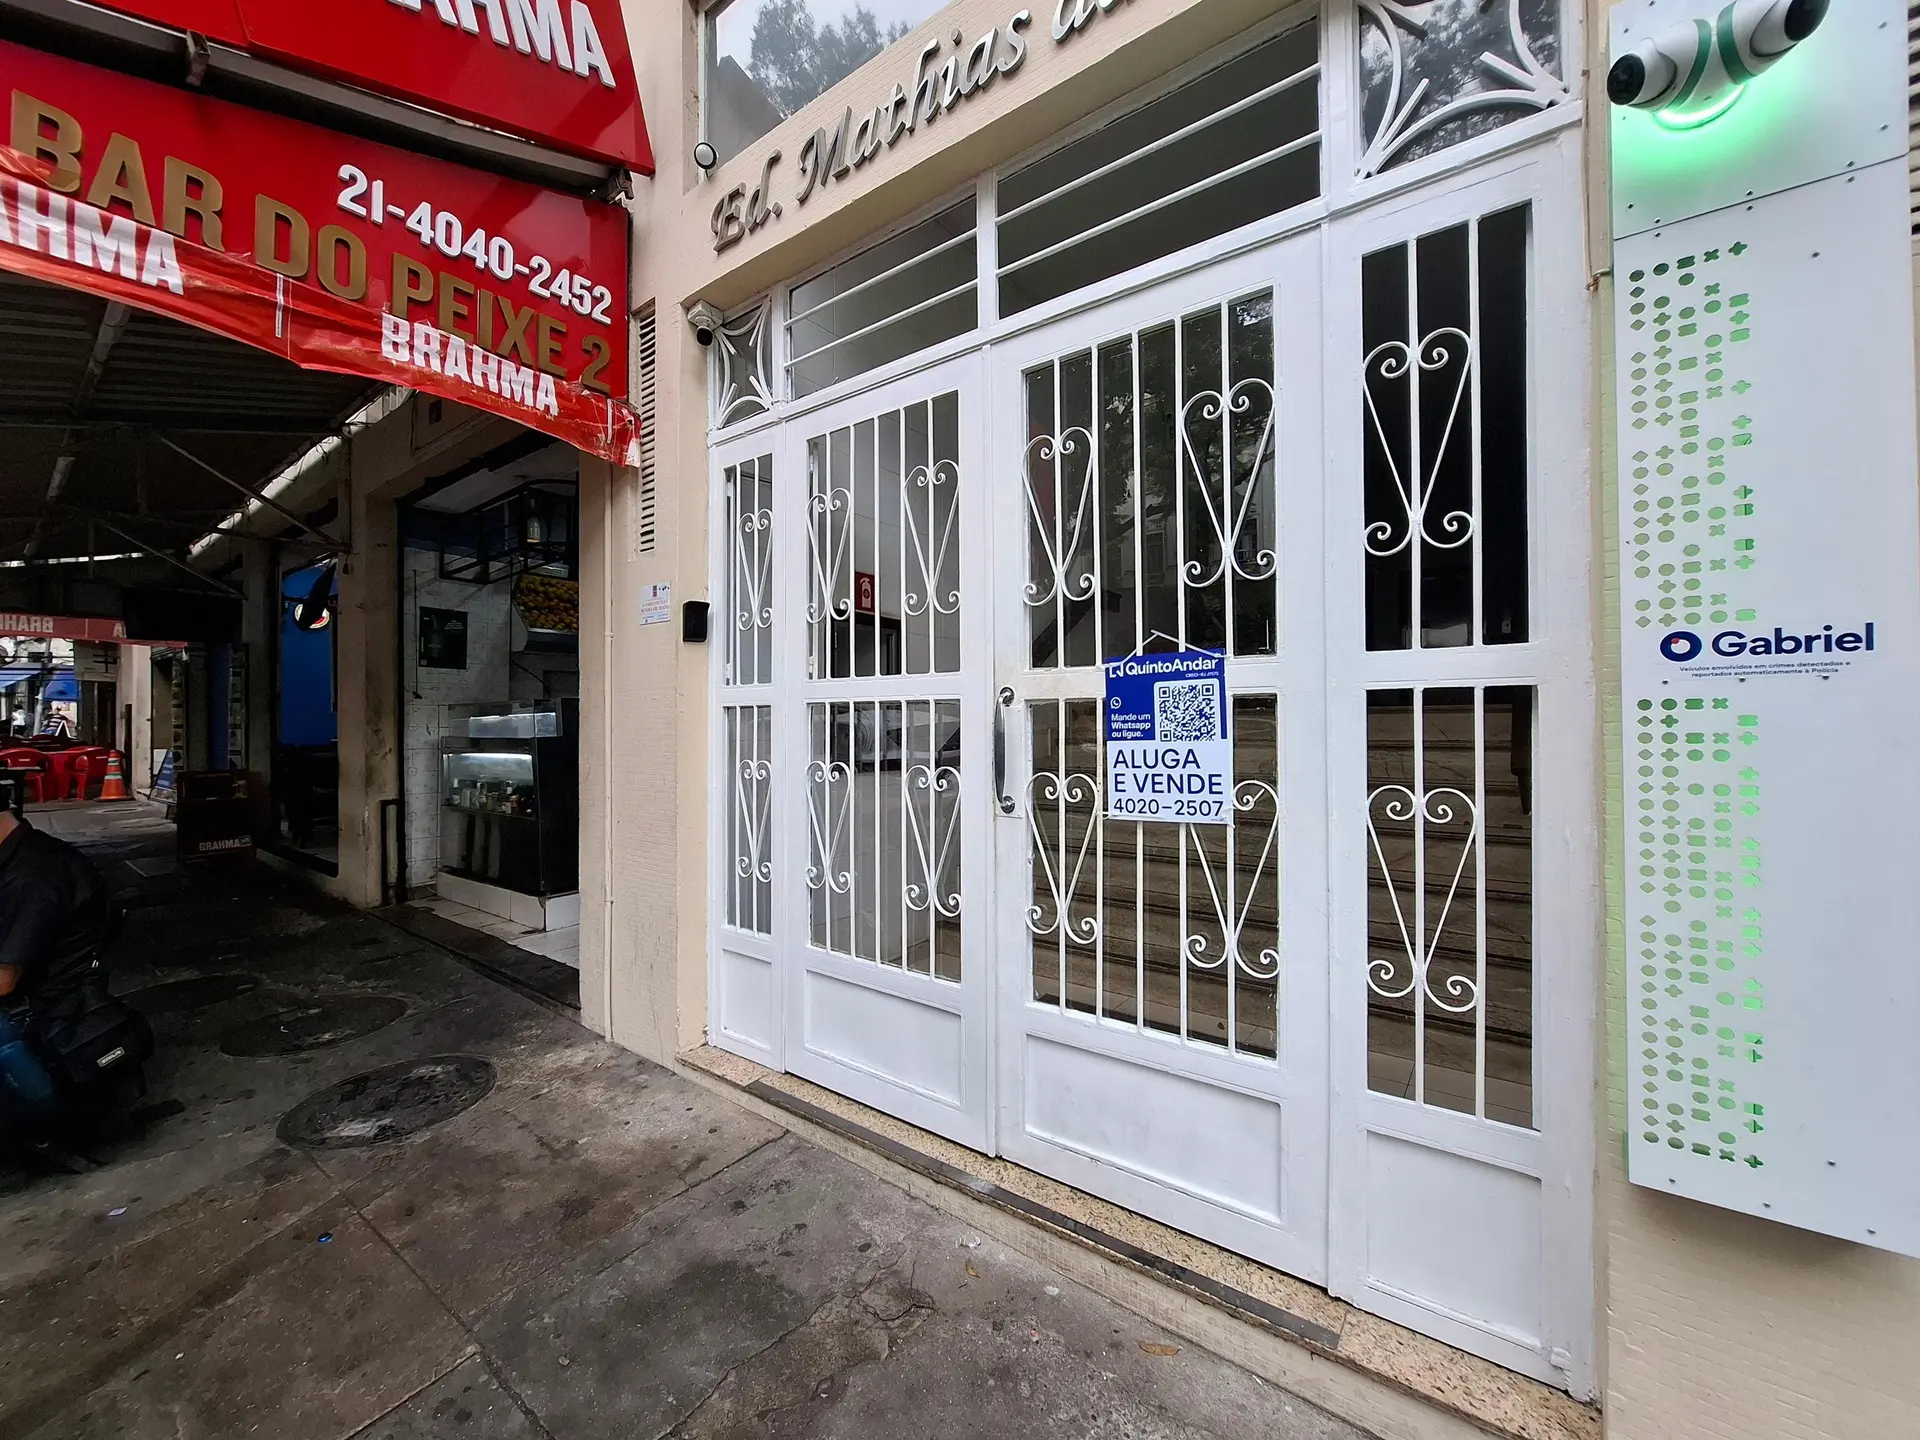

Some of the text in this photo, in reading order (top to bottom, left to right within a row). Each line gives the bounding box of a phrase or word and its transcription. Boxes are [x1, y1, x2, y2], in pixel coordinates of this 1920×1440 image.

[710, 9, 1031, 253] Ed. Mathias
[10, 88, 612, 394] BAR DO PEIXE 2
[337, 164, 613, 325] 21-4040-2452
[380, 312, 559, 416] BRAHMA
[1711, 622, 1875, 658] Gabriel
[1125, 657, 1219, 676] QuintoAndar
[1711, 663, 1752, 671] envolvidos
[1797, 660, 1844, 668] detectados
[1733, 668, 1803, 676] automaticamente
[1111, 713, 1137, 721] Mande
[1111, 721, 1151, 730] Whatsapp
[1122, 729, 1144, 739] ligue.
[1113, 749, 1201, 769] ALUGA
[1114, 773, 1223, 795] E VENDE
[1113, 798, 1224, 817] 4020-2507
